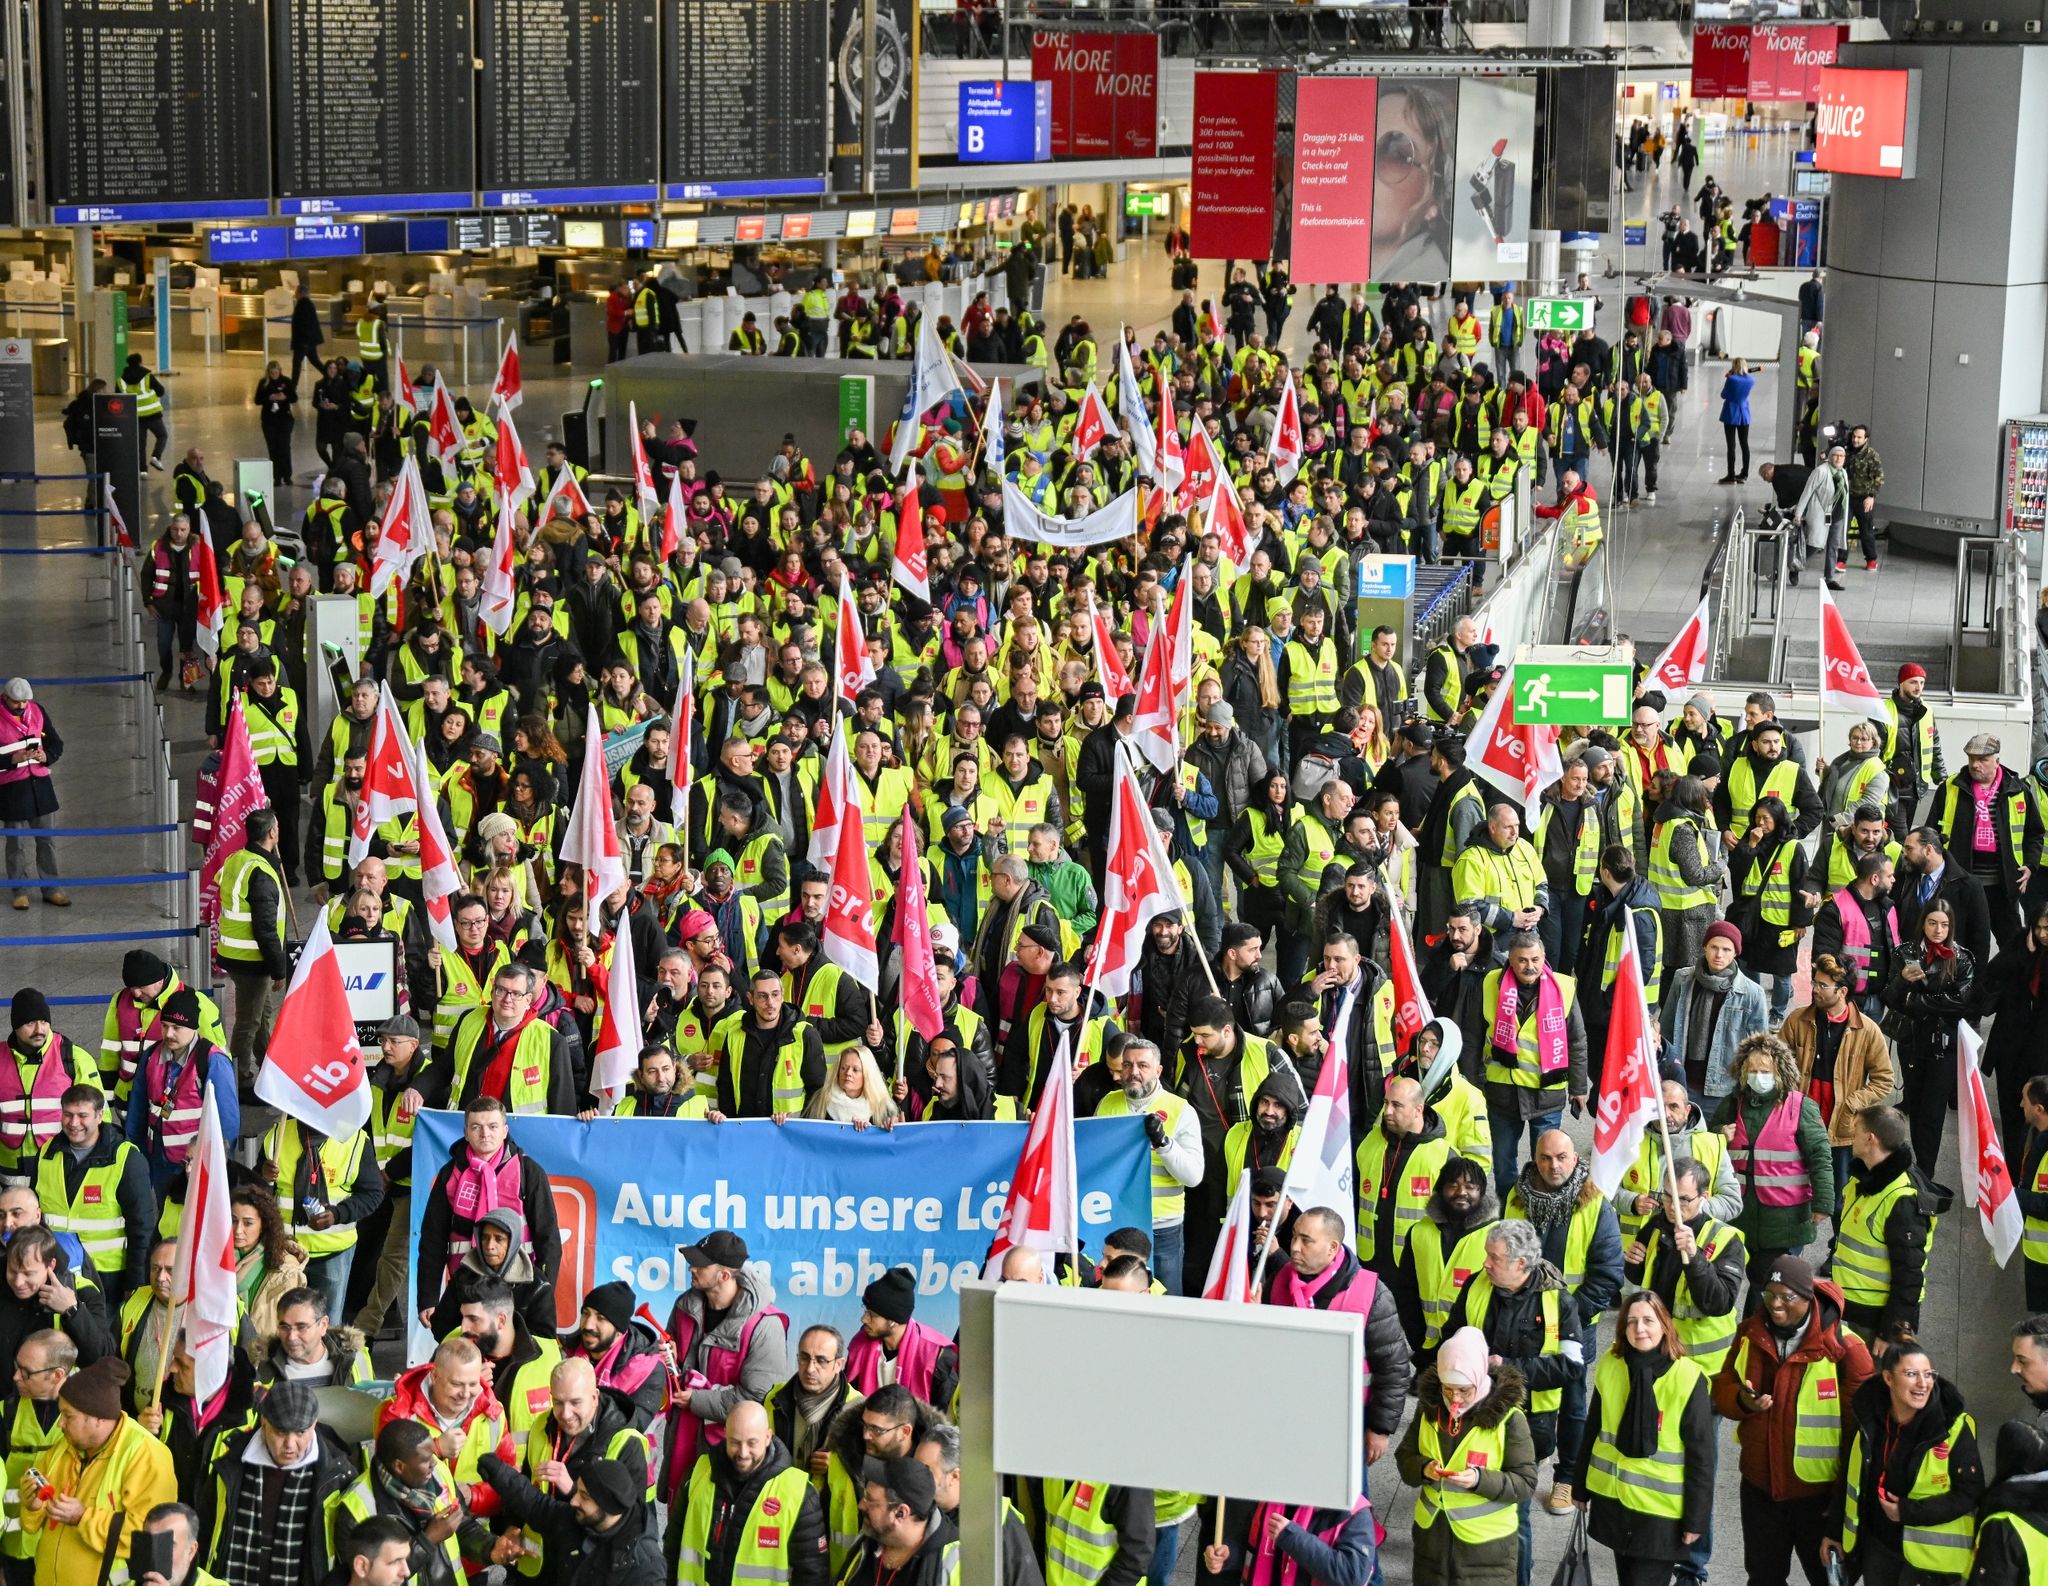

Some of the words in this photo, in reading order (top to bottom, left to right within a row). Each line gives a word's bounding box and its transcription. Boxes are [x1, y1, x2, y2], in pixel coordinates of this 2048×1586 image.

[1766, 36, 1807, 52] MORE
[1054, 49, 1113, 72] MORE
[1793, 50, 1834, 66] MORE
[1095, 73, 1154, 96] MORE
[967, 86, 994, 95] Terminal
[967, 99, 1002, 108] Abflughalle
[1198, 115, 1215, 125] One
[1199, 128, 1214, 138] 300
[1302, 132, 1337, 145] Dragging
[1337, 132, 1348, 143] 25
[1348, 132, 1365, 143] kilos
[967, 125, 985, 153] B
[1197, 141, 1213, 150] and
[1214, 141, 1235, 150] 1000
[1302, 146, 1310, 157] in
[1317, 147, 1342, 159] hurry?
[1197, 154, 1239, 165] possibilities
[1239, 154, 1256, 163] that
[1301, 160, 1333, 171] Check-in
[1333, 160, 1349, 171] and
[1197, 167, 1213, 176] take
[1214, 168, 1229, 177] you
[1300, 174, 1319, 185] treat
[1319, 174, 1349, 187] yourself.
[1197, 191, 1212, 201] This
[1213, 192, 1220, 201] is
[1300, 202, 1315, 213] This
[1315, 203, 1323, 213] is
[250, 229, 258, 243] C
[611, 1179, 747, 1230] Auch
[764, 1194, 943, 1232] unsere
[957, 1181, 1112, 1231] Löe
[1818, 1390, 1837, 1398] ver.di
[759, 1538, 779, 1547] ver.di
